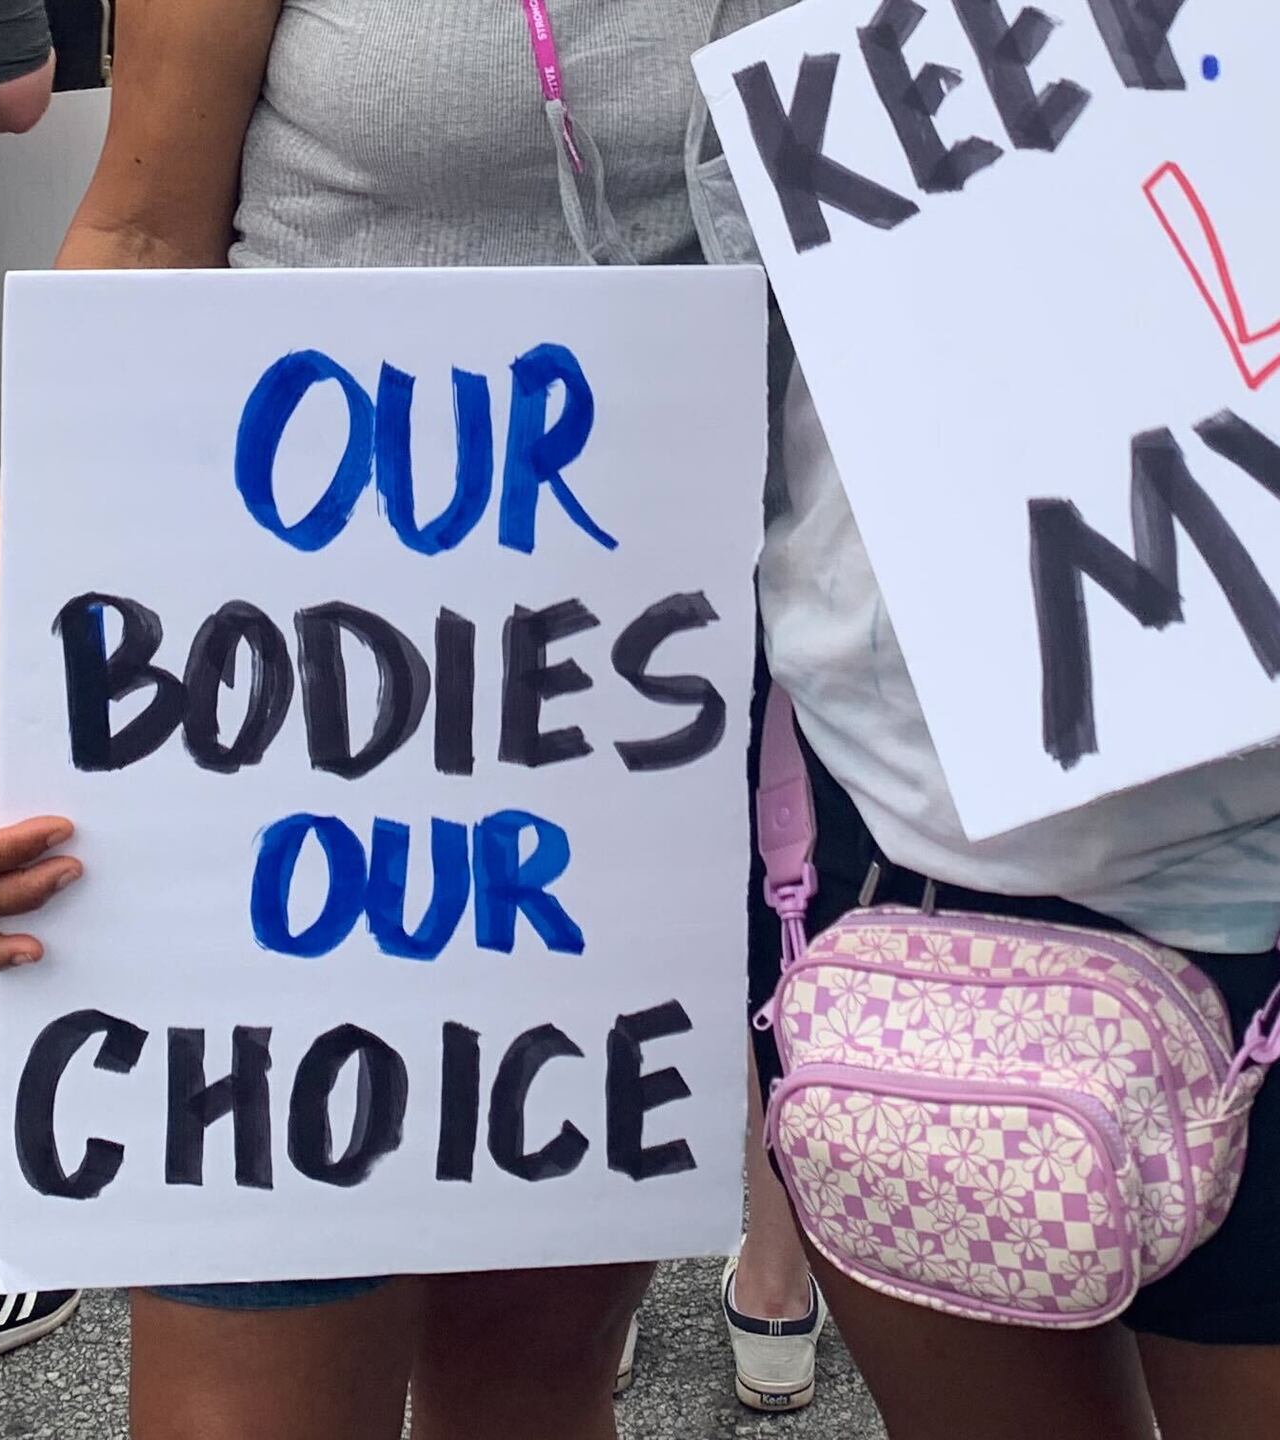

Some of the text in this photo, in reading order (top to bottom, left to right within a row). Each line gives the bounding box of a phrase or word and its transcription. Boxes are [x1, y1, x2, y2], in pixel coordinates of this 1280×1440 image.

[234, 342, 620, 556] OUR
[51, 590, 727, 781] BODIES
[249, 809, 586, 961] OUR
[14, 999, 698, 1200] CHOICE
